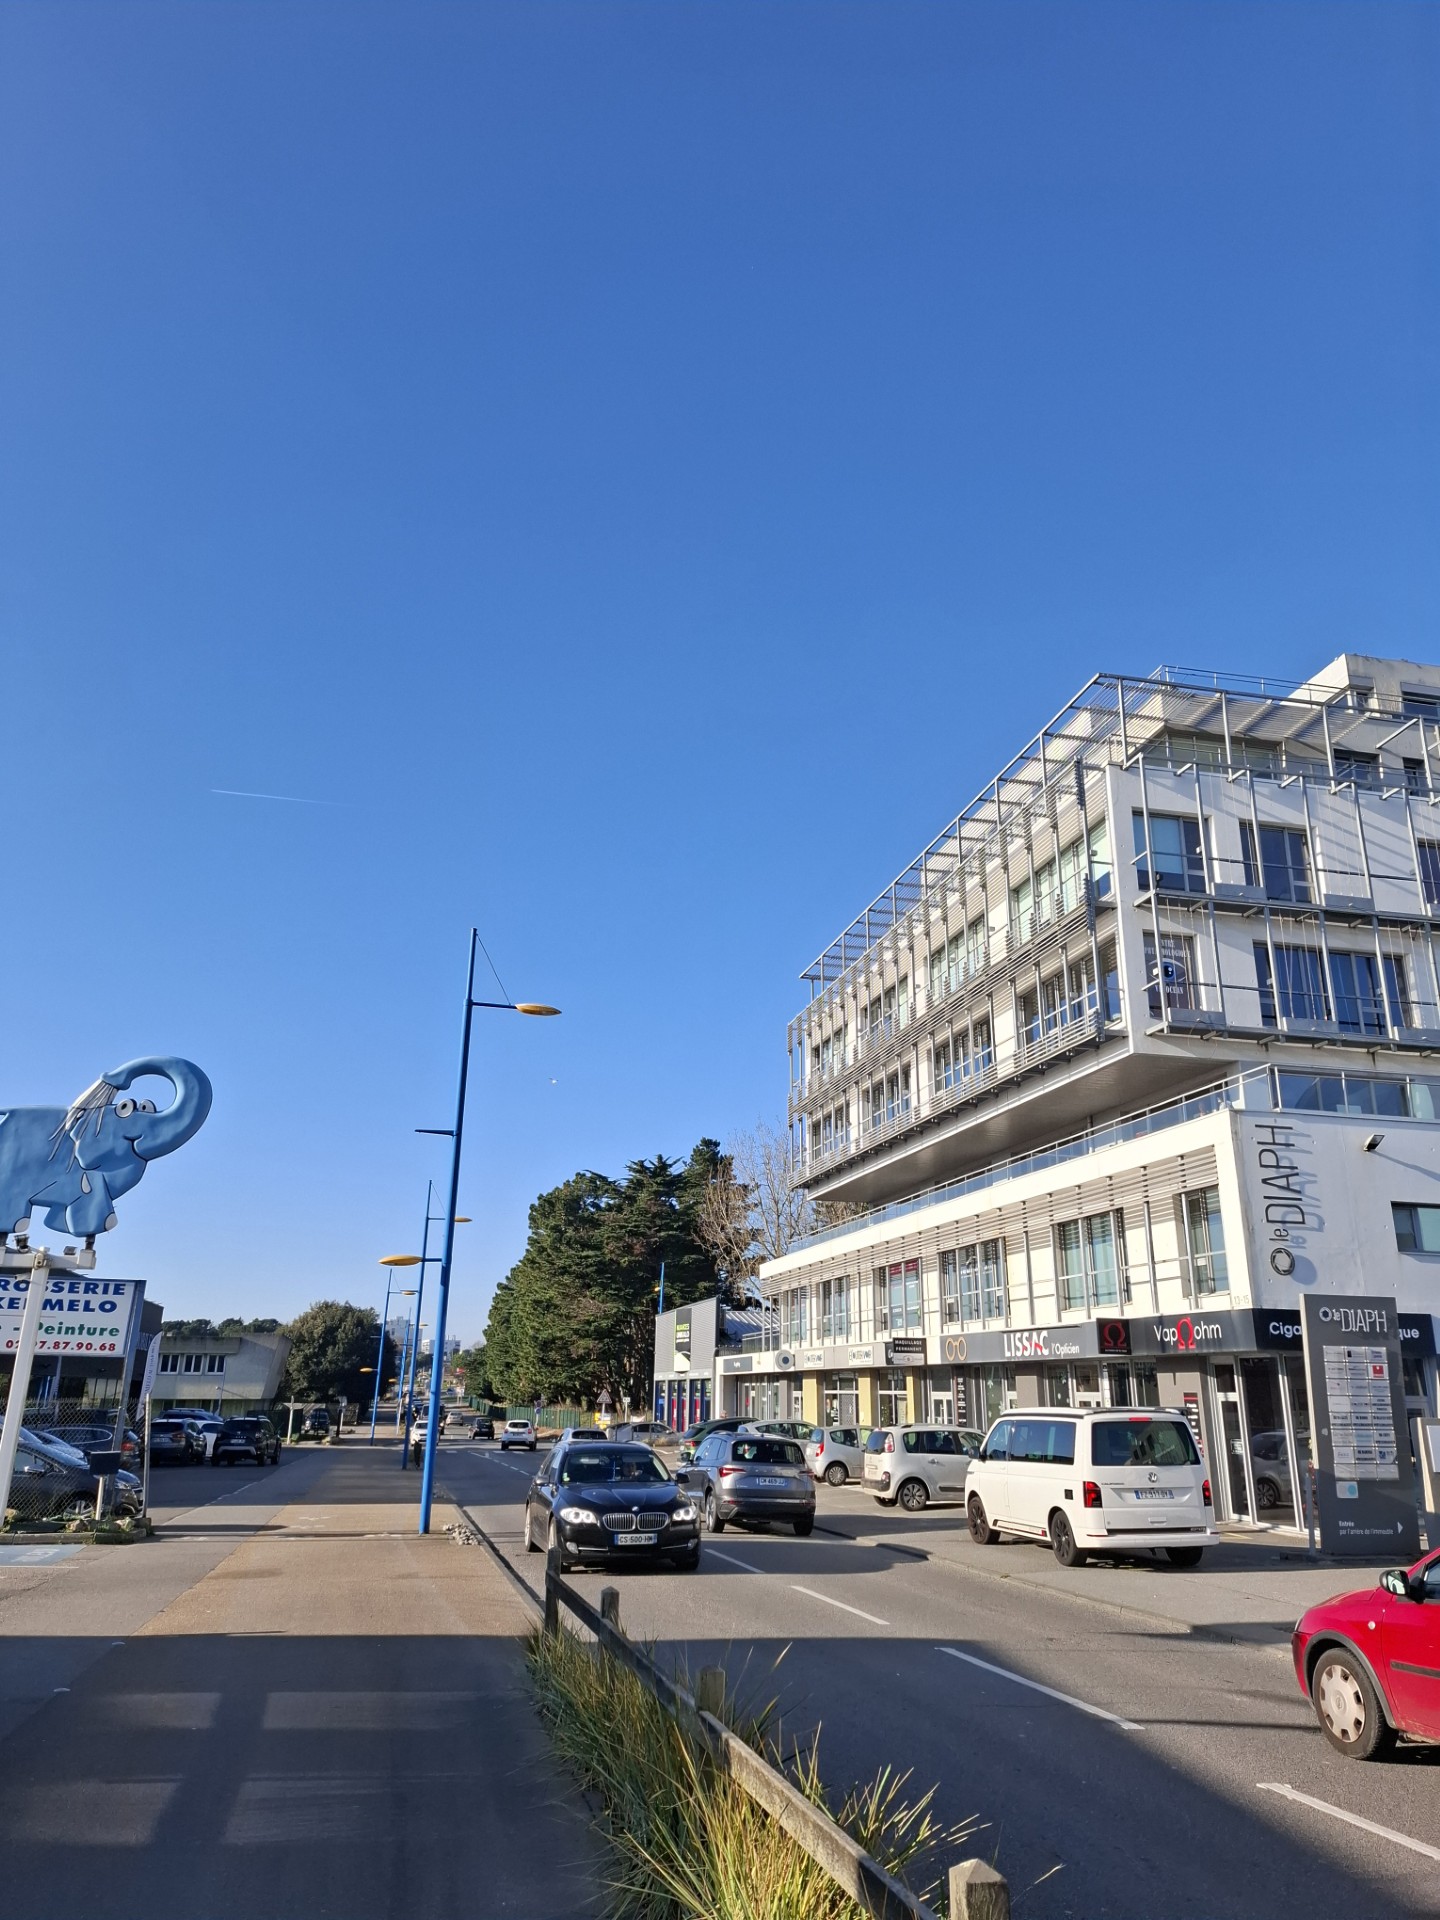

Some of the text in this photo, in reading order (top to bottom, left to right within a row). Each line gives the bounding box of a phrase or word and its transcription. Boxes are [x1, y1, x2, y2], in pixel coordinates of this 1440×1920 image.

[1255, 1124, 1306, 1225] DIAPH
[0, 1279, 126, 1296] ROSERIE
[0, 1297, 117, 1313] EMELO
[1340, 1308, 1387, 1332] DIAPH
[5, 1340, 116, 1351] 07.87.90.68
[1003, 1330, 1049, 1357] LISSAC
